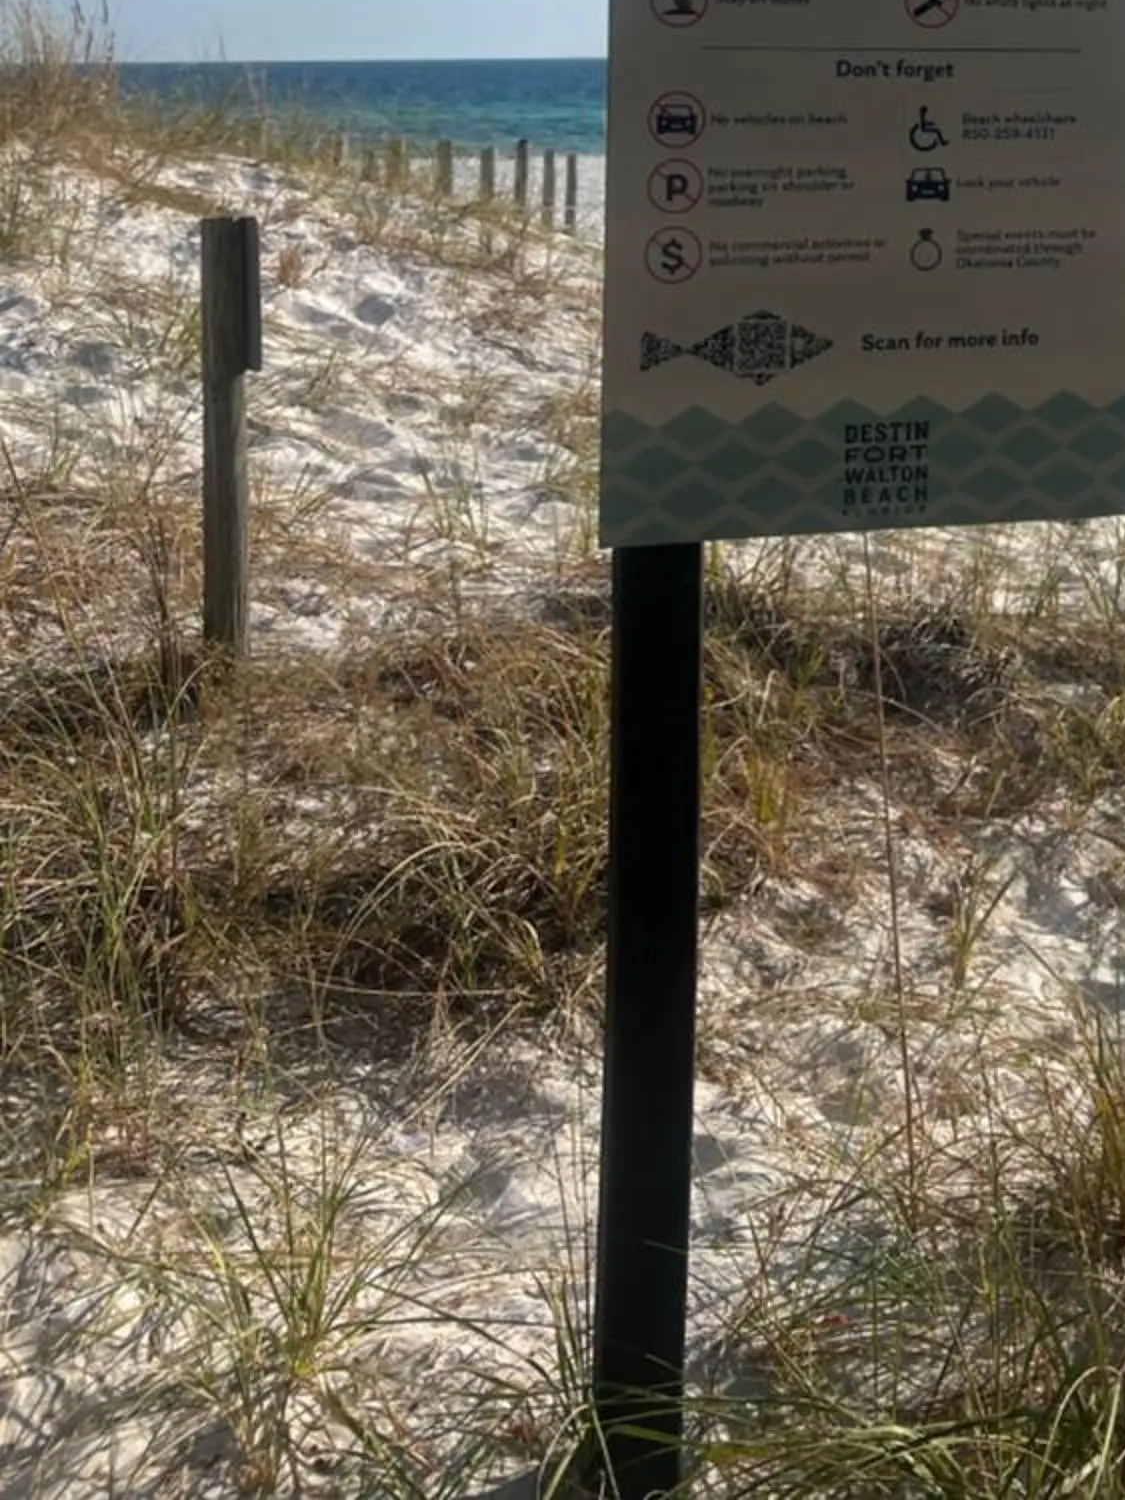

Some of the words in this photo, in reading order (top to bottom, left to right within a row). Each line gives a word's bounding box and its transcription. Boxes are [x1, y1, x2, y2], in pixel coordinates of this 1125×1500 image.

[836, 59, 890, 77] Don't
[896, 60, 955, 82] forget
[710, 112, 730, 125] No
[861, 334, 910, 351] Scan
[916, 331, 943, 348] for
[949, 334, 997, 348] more
[1002, 327, 1039, 346] info
[844, 421, 929, 444] DESTIN
[844, 445, 927, 463] FORT
[844, 464, 929, 484] WALTON
[843, 484, 928, 505] BEACH
